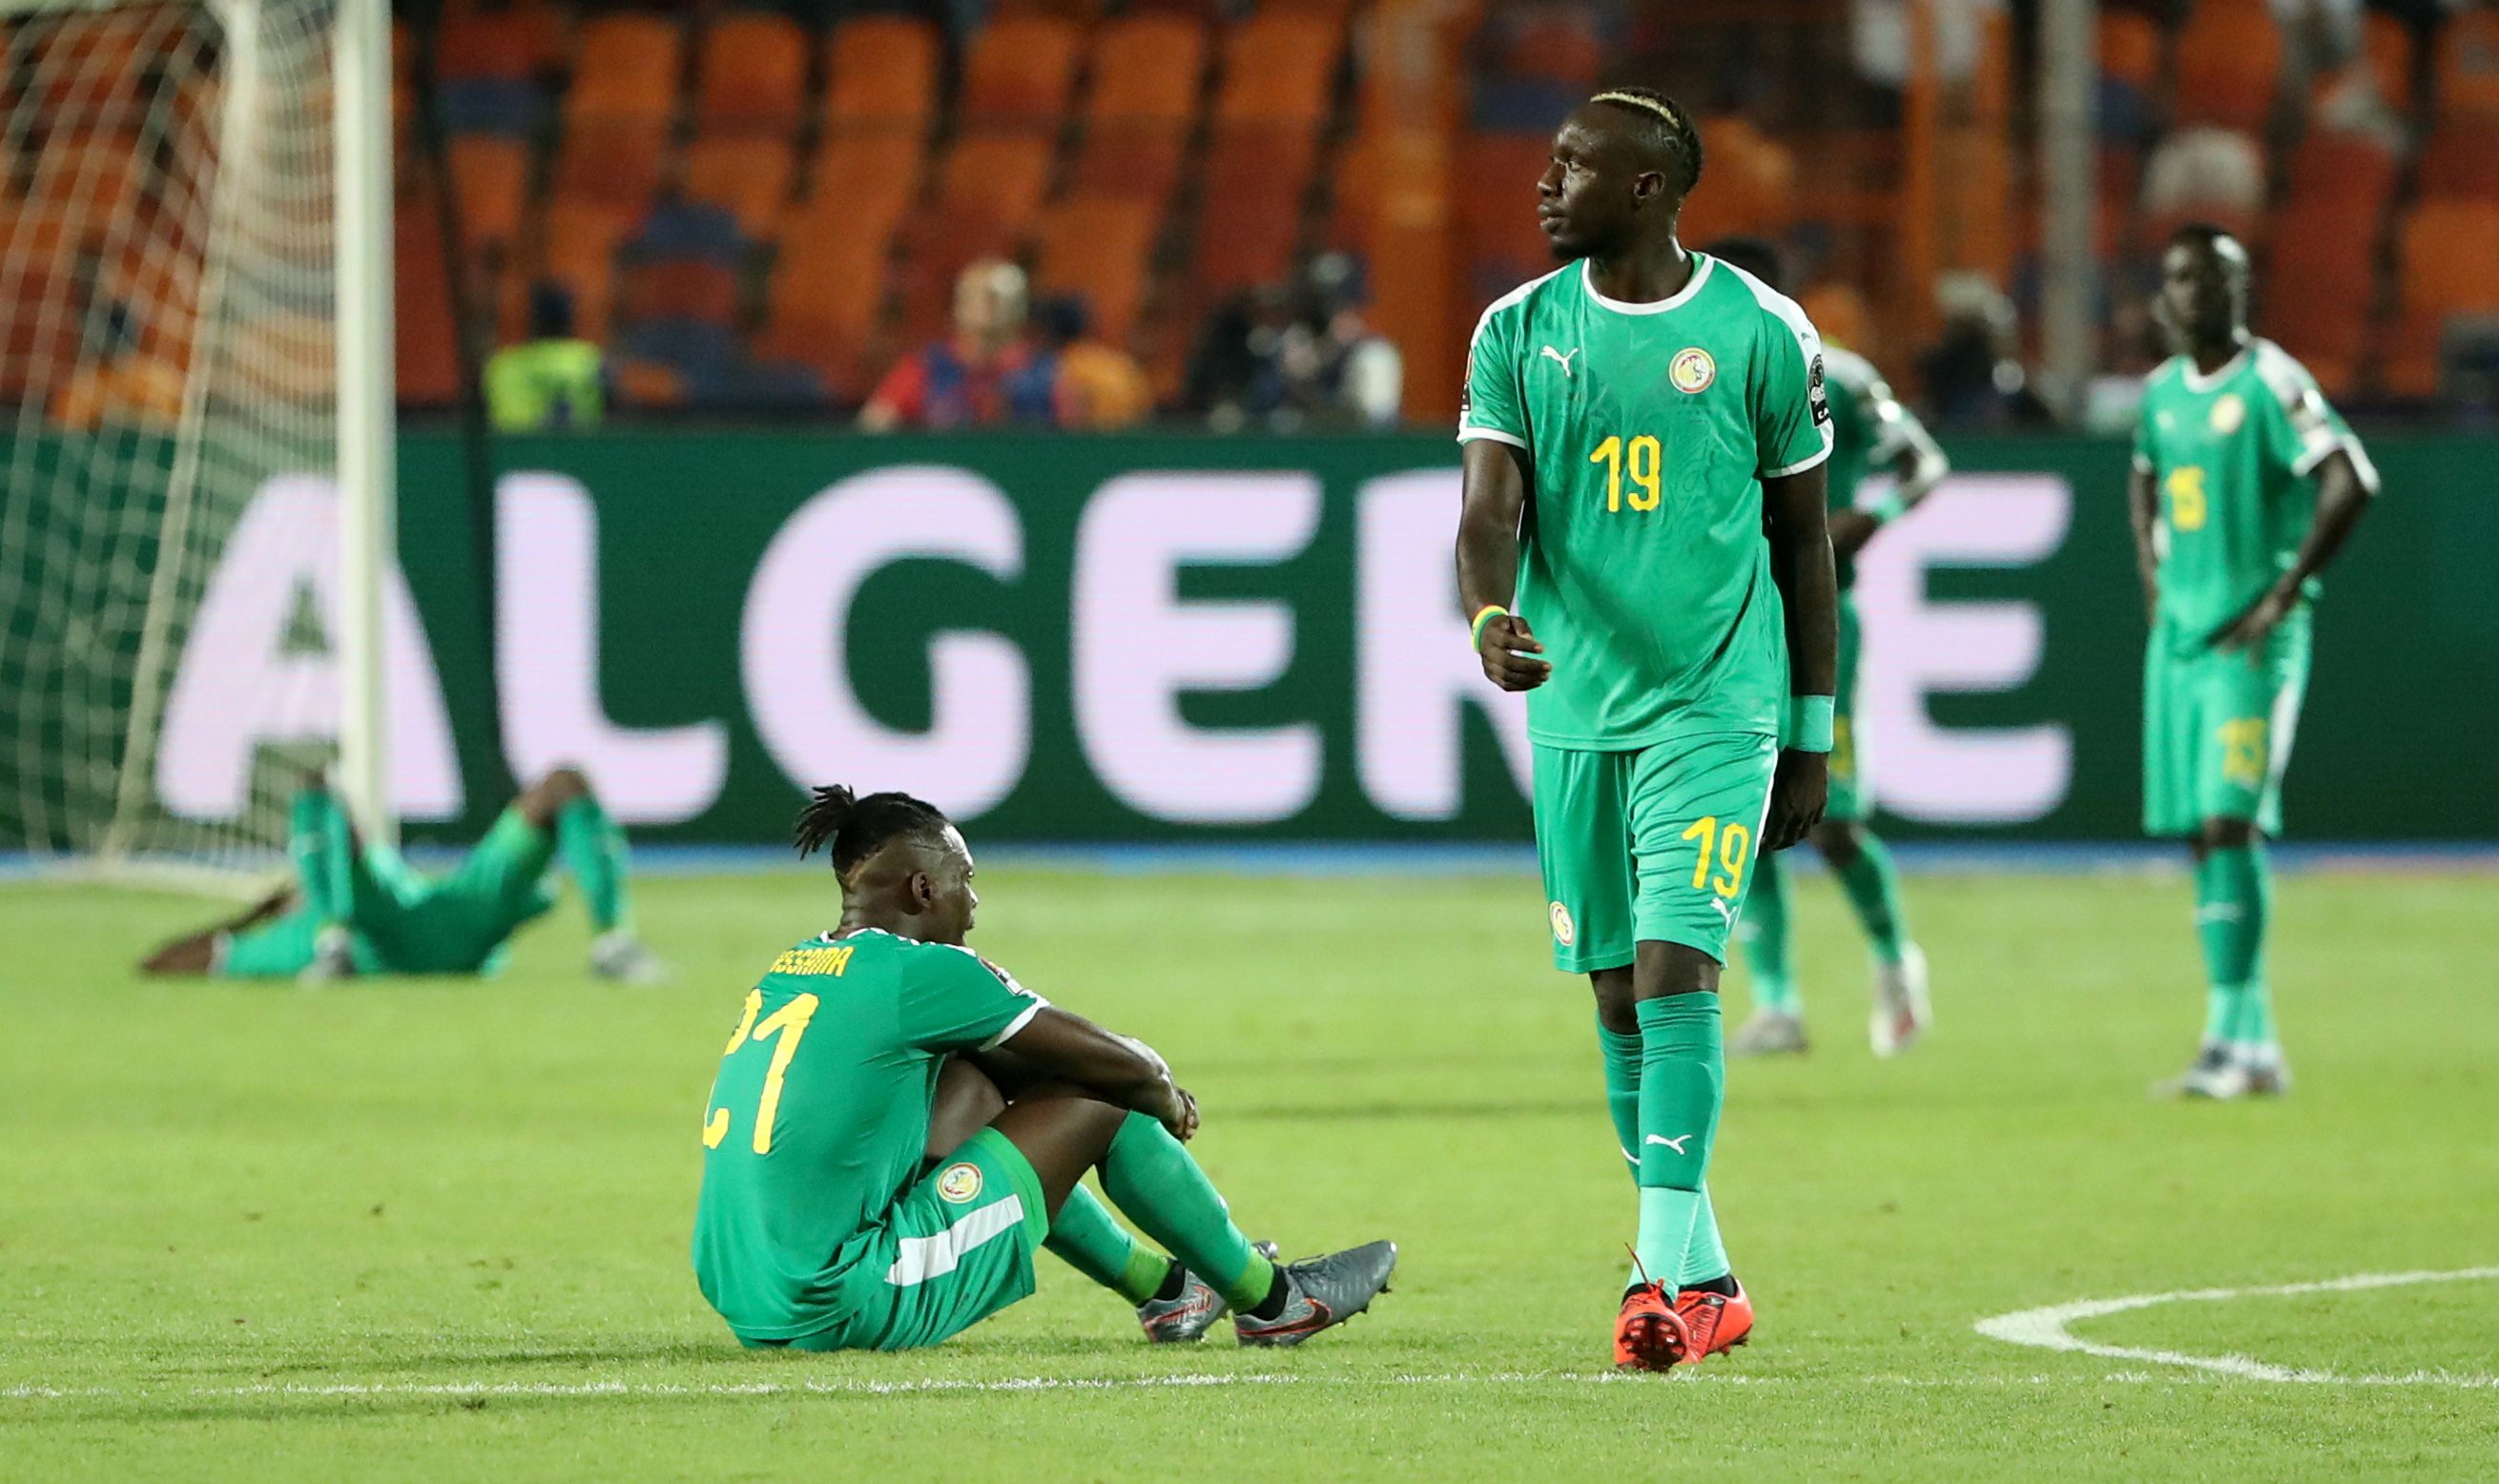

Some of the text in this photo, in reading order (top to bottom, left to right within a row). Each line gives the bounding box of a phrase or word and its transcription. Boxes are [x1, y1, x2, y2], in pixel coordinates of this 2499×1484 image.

[1590, 435, 1662, 512] 19
[155, 466, 2074, 824] ALGERE
[1682, 815, 1749, 897] 19
